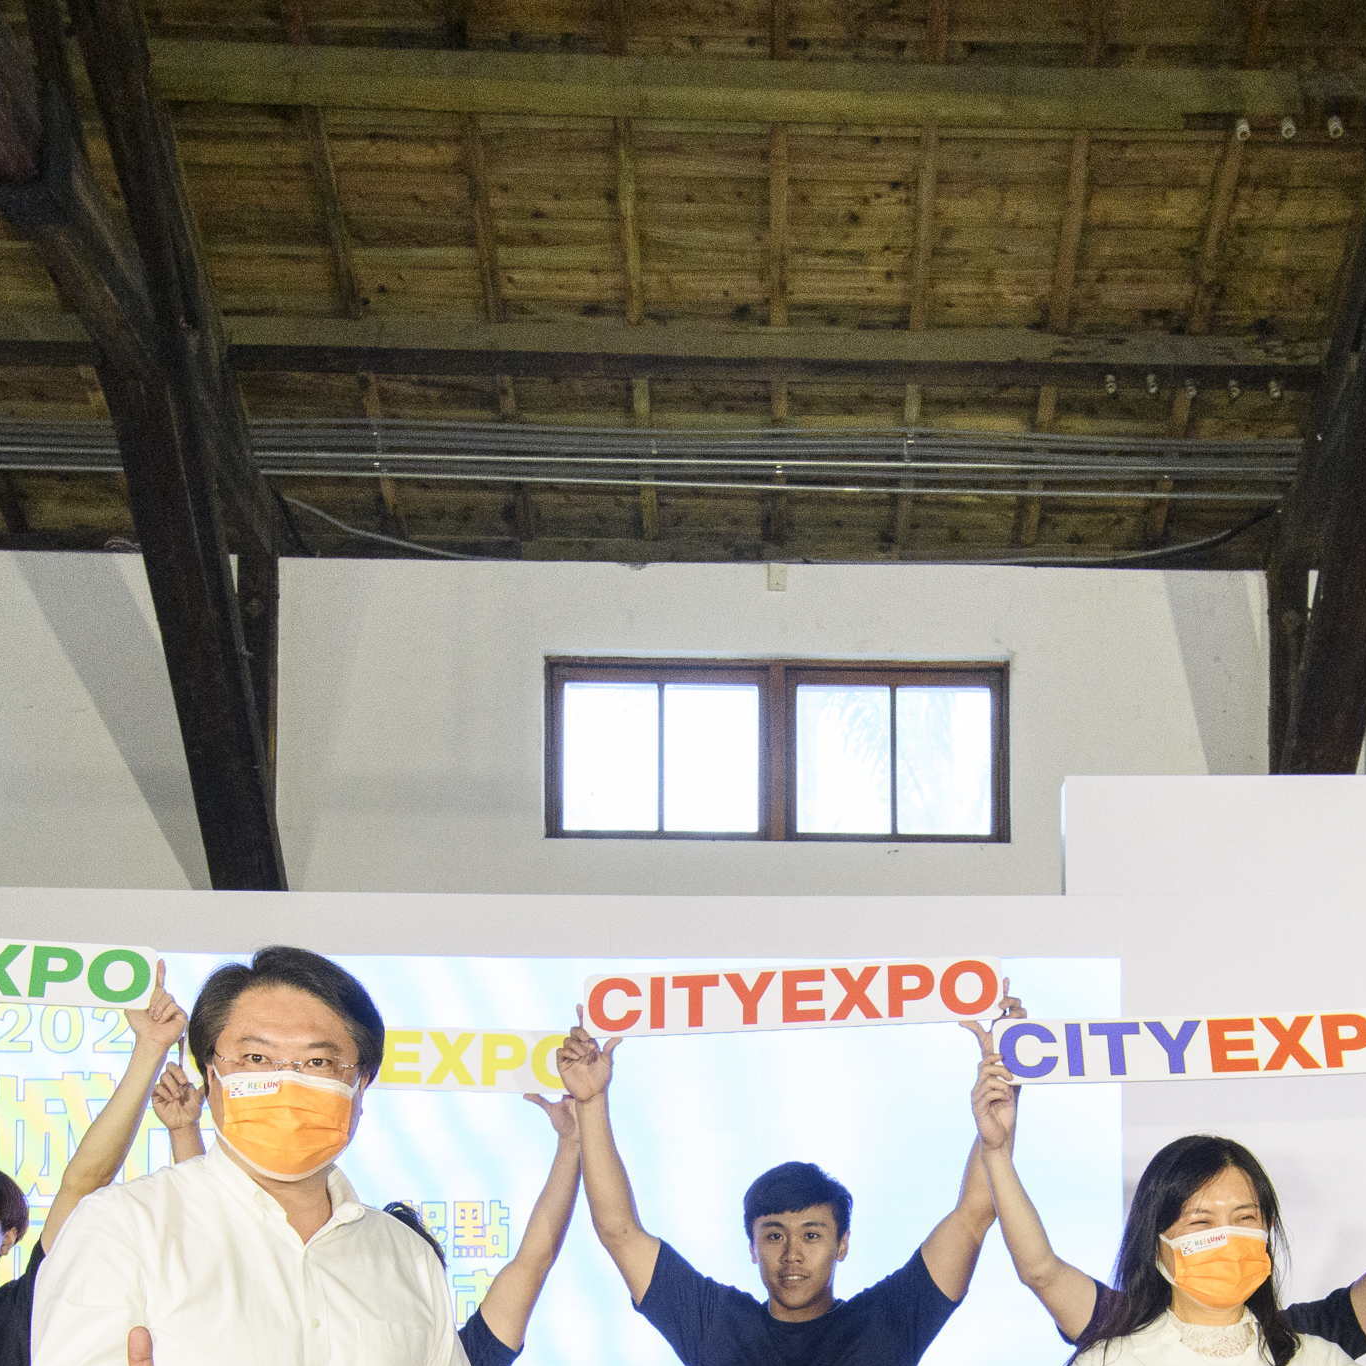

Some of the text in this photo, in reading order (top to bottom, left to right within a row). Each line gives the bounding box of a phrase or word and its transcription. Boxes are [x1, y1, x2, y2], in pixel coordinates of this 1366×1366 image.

[587, 958, 998, 1033] CITYEXPO
[378, 1030, 569, 1089] EXPO
[1194, 1233, 1226, 1246] KEELUNG
